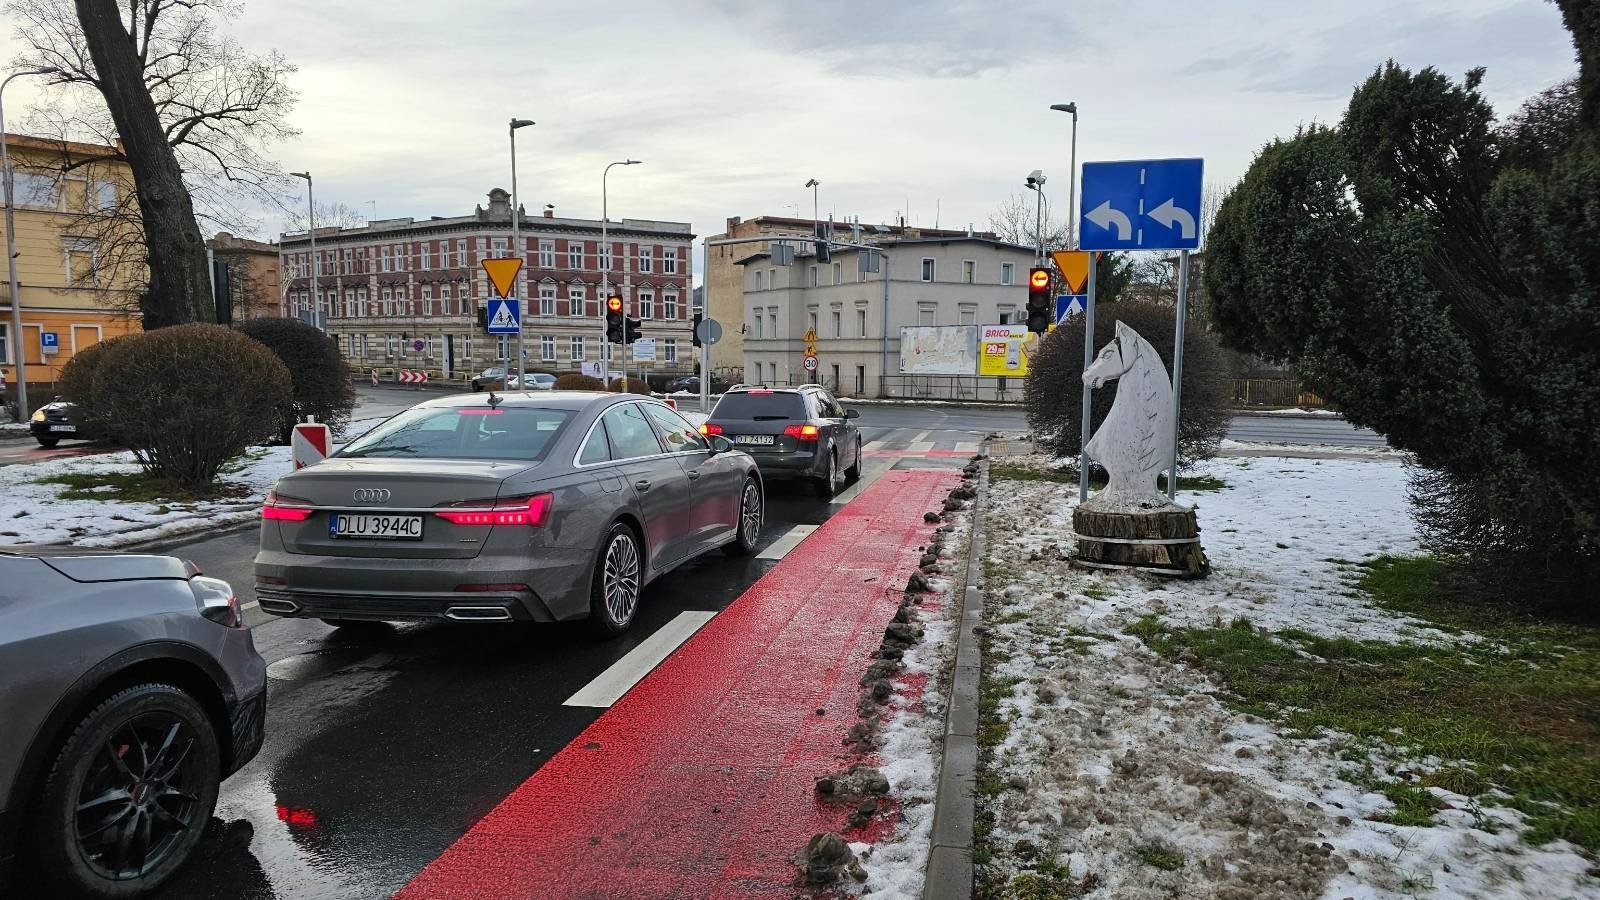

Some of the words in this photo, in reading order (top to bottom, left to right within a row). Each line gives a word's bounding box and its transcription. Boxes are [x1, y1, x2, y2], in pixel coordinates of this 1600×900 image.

[985, 329, 1010, 338] BRICO
[45, 333, 55, 344] P
[805, 359, 816, 368] 30
[750, 435, 773, 444] 74132
[337, 516, 367, 534] DLU
[371, 517, 420, 535] 3944C
